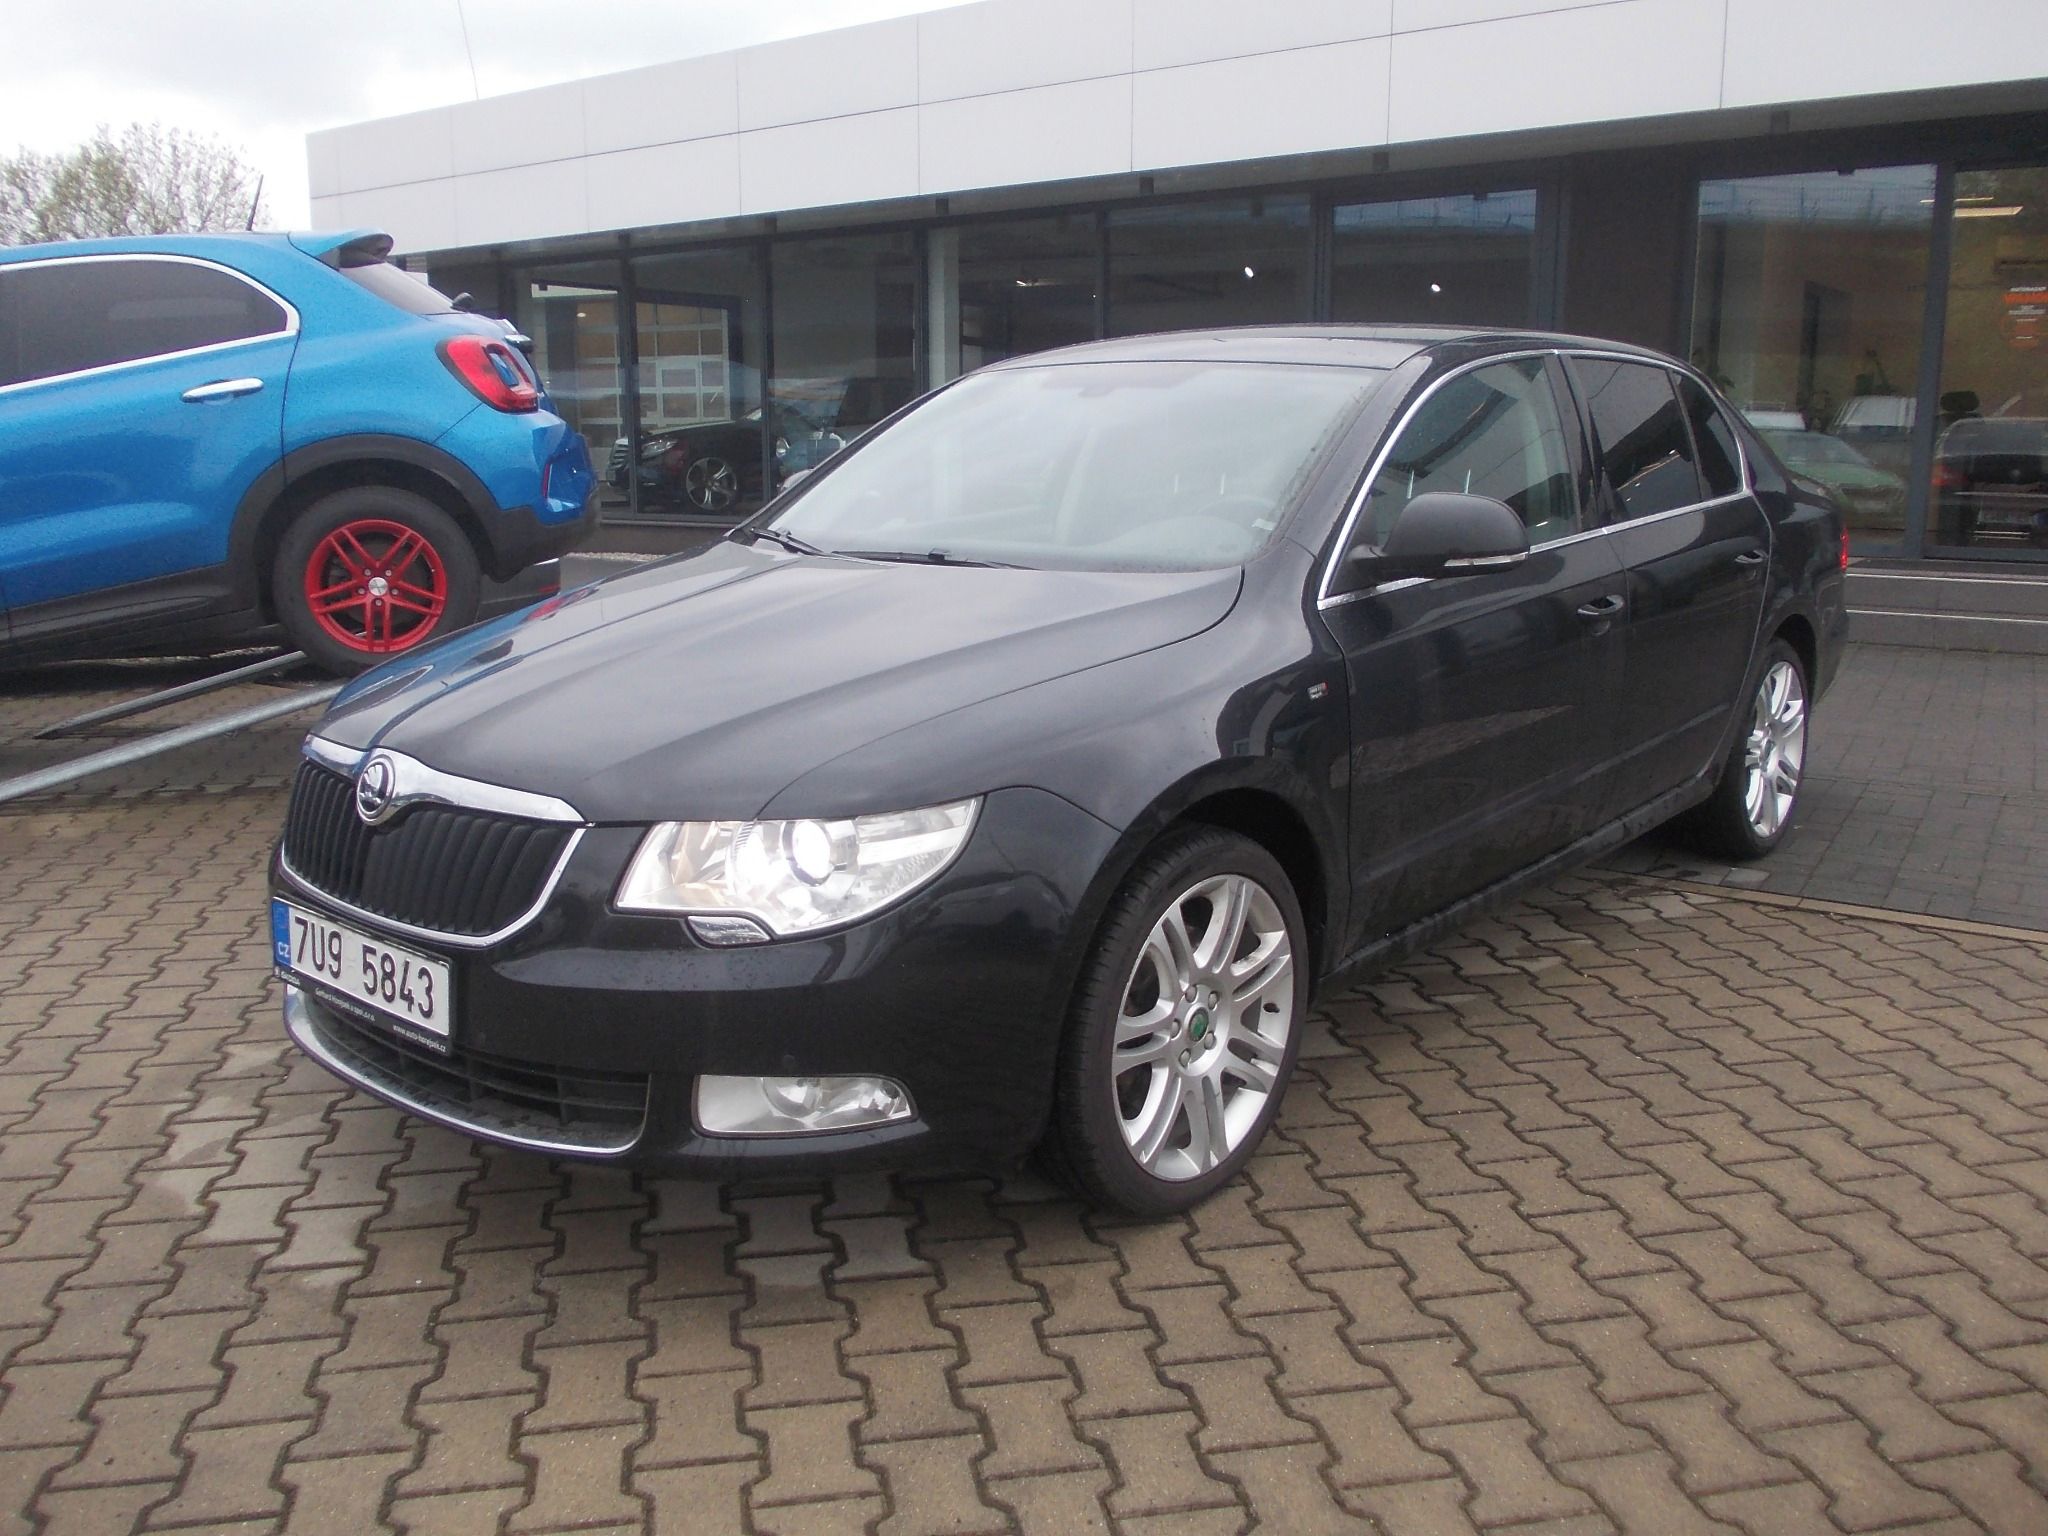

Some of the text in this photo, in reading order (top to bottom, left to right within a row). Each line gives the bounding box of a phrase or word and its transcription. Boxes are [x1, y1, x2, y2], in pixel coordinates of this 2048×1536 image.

[278, 941, 290, 958] CZ
[295, 916, 434, 1019] 7U9 5843
